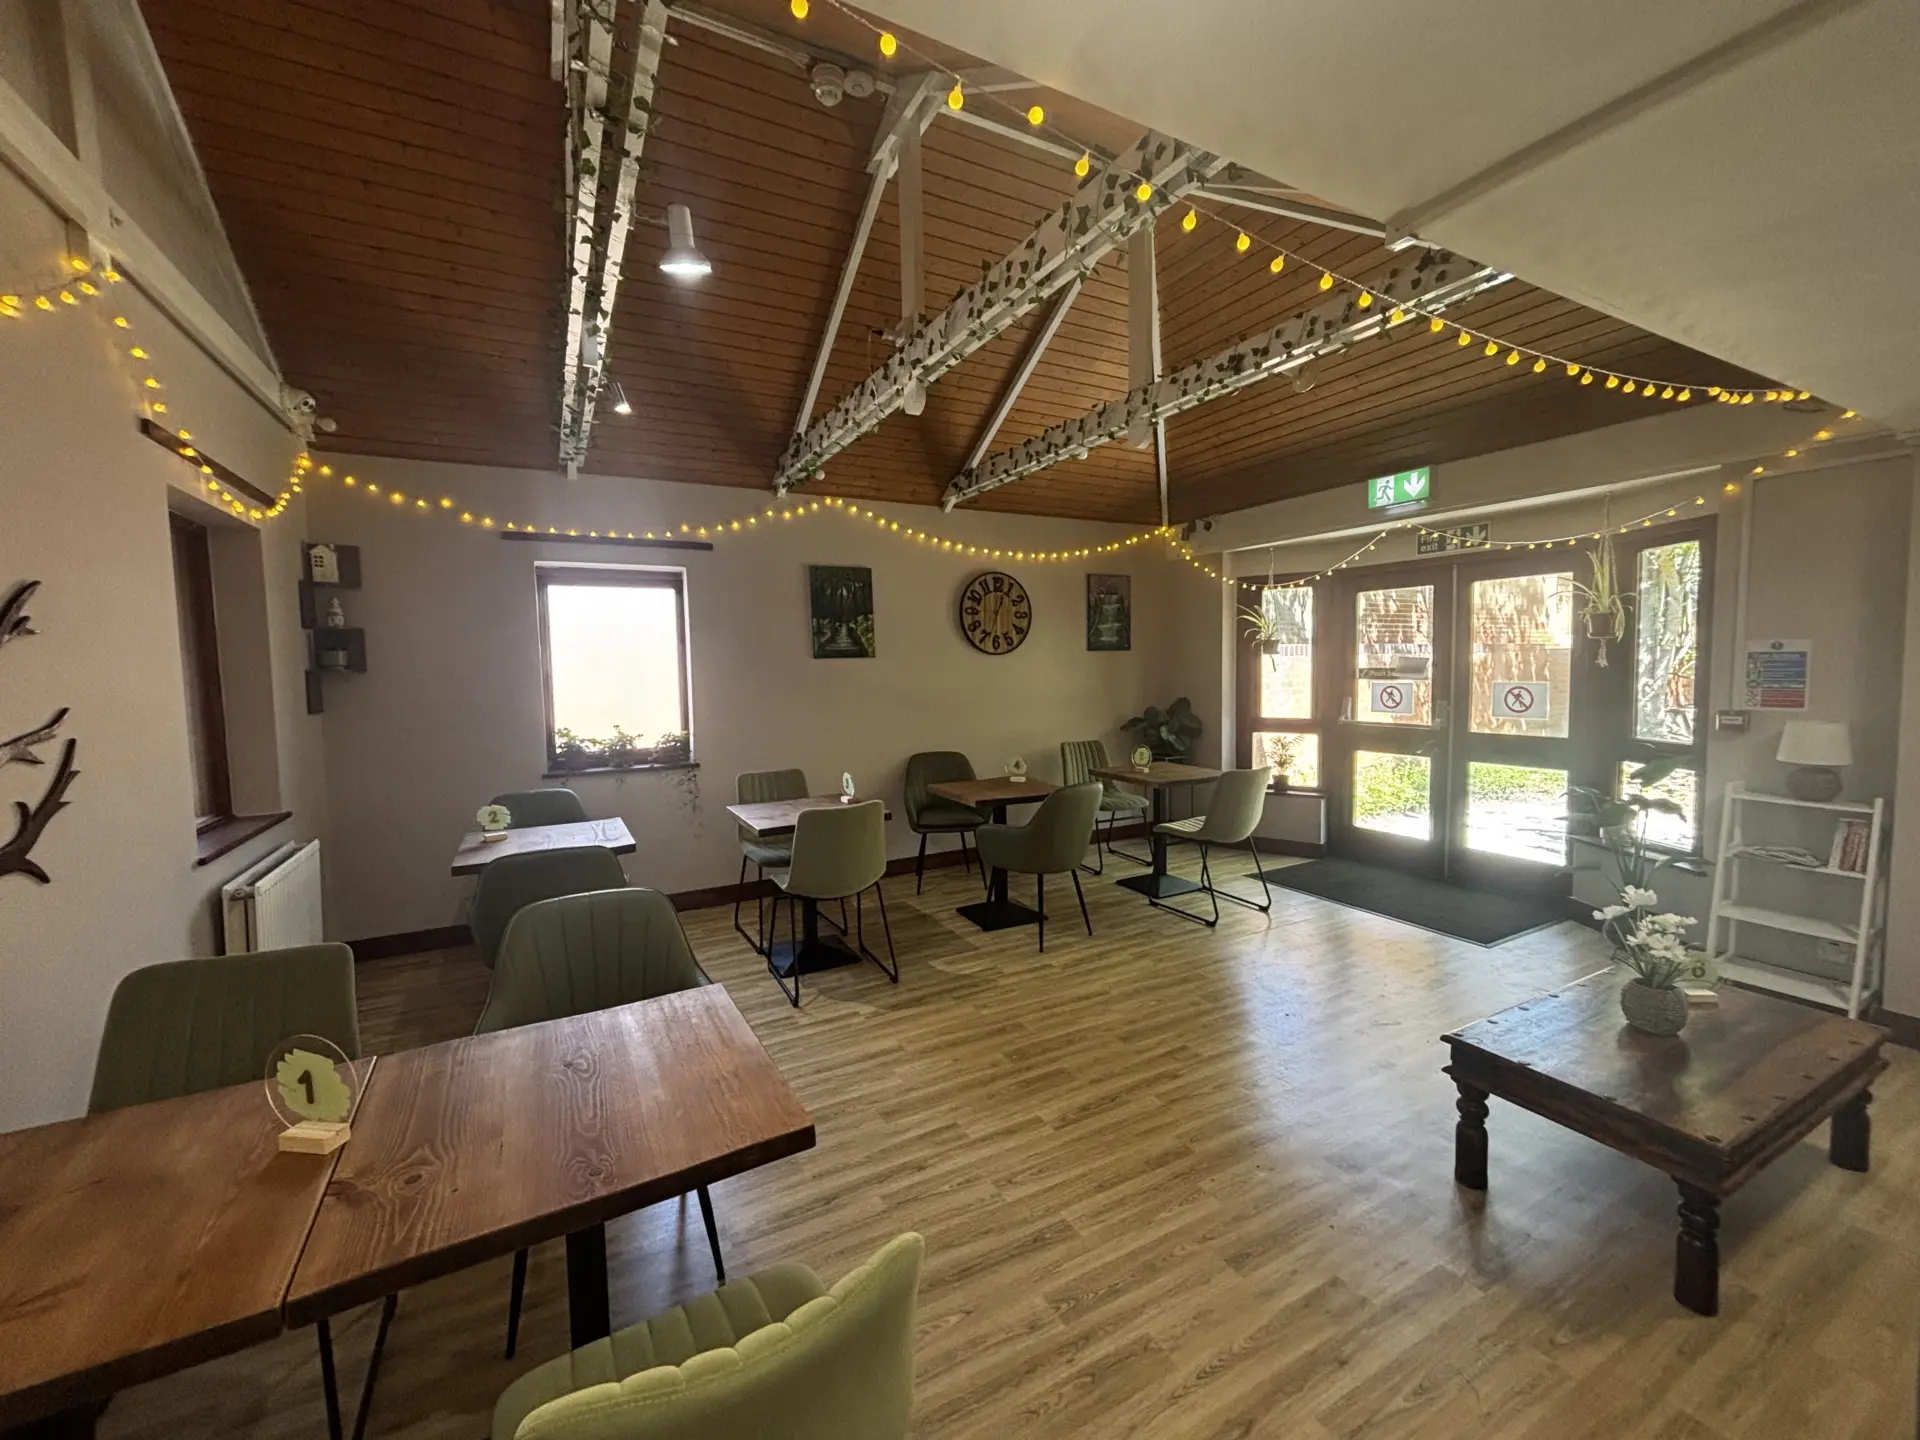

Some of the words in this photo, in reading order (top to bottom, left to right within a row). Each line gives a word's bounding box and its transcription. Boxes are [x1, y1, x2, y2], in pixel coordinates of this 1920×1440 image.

[1420, 534, 1440, 544] Fire
[1420, 542, 1439, 552] exit
[978, 577, 992, 596] 11
[992, 576, 1005, 593] 12
[1003, 582, 1014, 597] 1
[967, 589, 982, 606] 10
[1011, 594, 1025, 607] 2
[964, 606, 980, 616] 9
[1014, 611, 1028, 620] 3
[967, 620, 982, 632] 8
[1012, 622, 1025, 635] 4
[979, 628, 991, 644] 7
[992, 634, 1001, 651] 6
[1002, 631, 1014, 646] 5
[488, 810, 500, 824] 2
[1692, 959, 1706, 978] 6
[298, 1069, 314, 1104] 1
